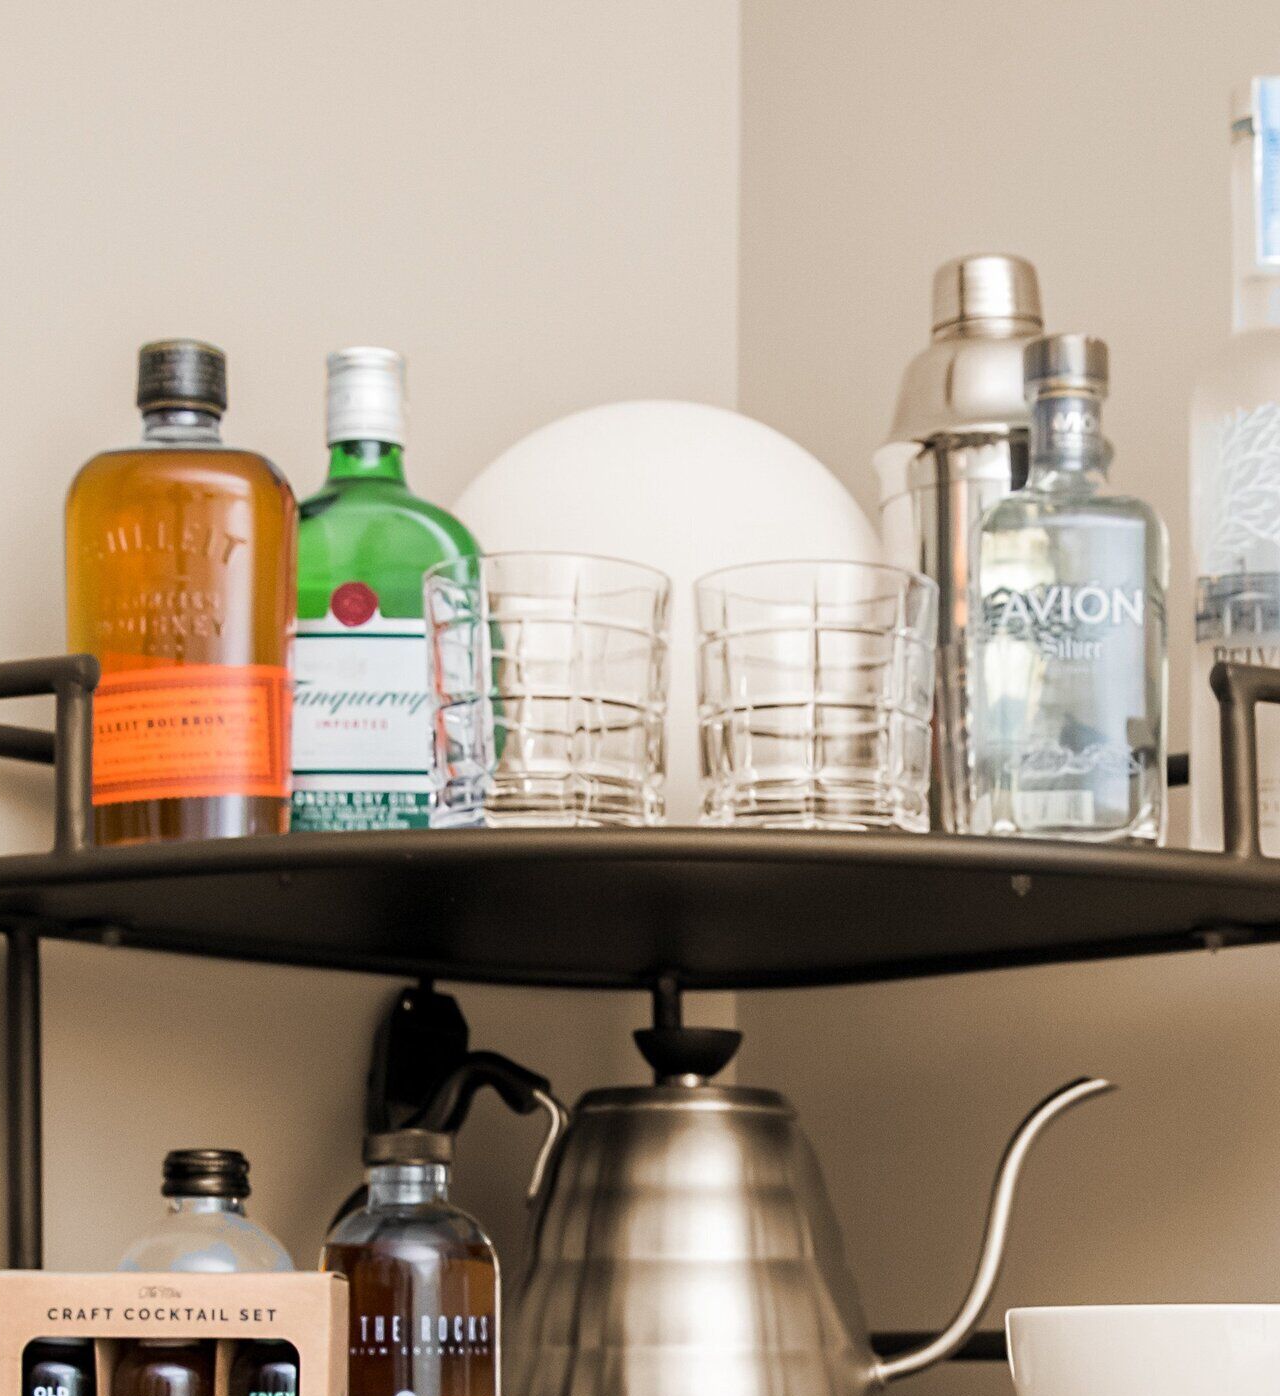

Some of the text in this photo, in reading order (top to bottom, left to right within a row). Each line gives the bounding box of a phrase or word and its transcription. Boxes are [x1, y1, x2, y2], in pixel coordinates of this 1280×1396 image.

[295, 680, 432, 716] anqueray
[47, 1308, 277, 1322] CRAFT COCKTAIL SET
